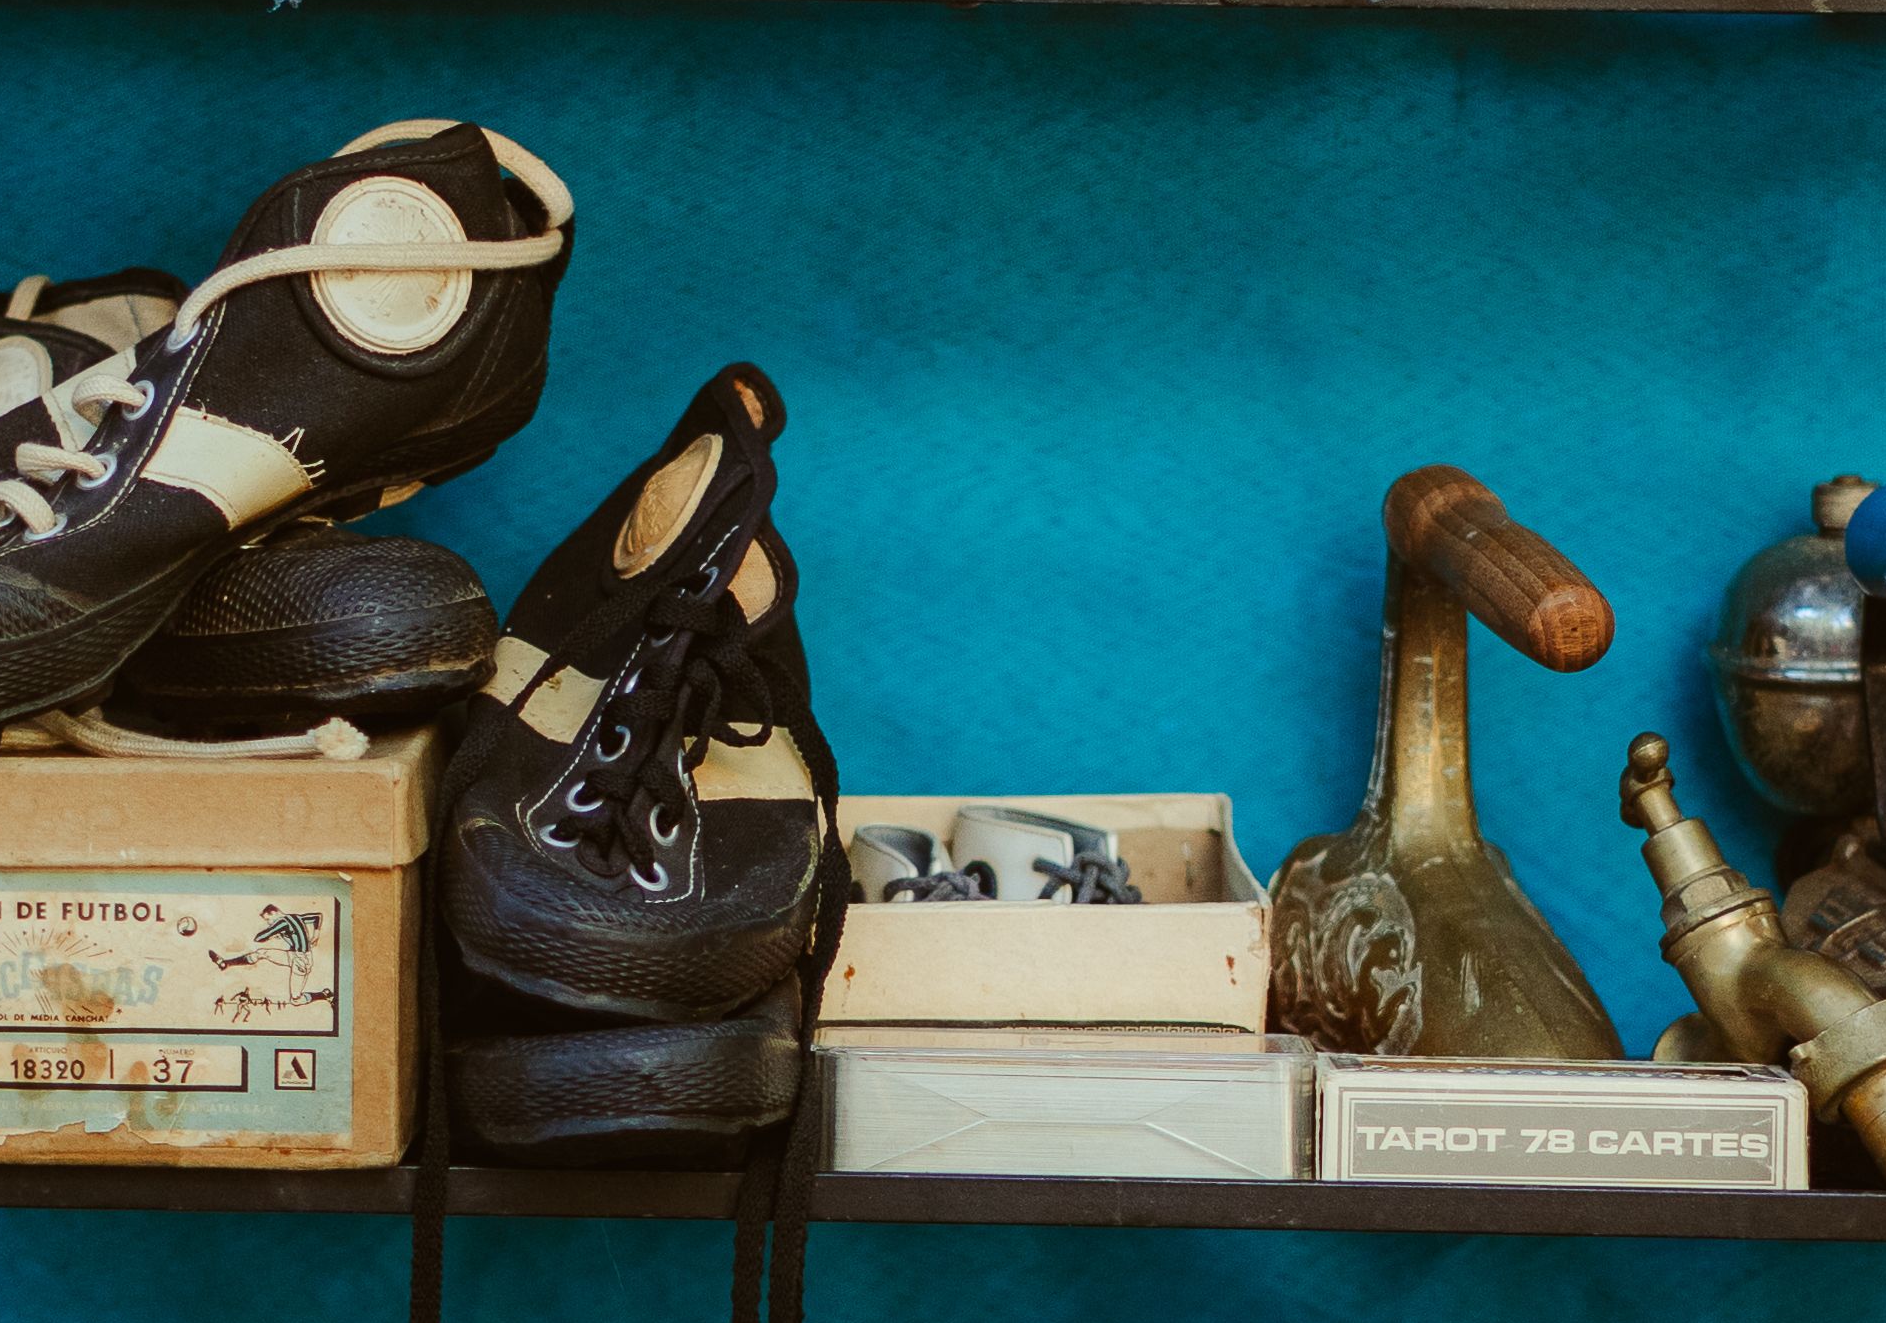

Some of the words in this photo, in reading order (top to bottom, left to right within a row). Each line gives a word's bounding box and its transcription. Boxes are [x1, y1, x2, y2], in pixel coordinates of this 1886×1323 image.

[16, 901, 48, 921] DE
[61, 902, 167, 923] FUTBOL
[14, 1014, 25, 1022] DE
[30, 1014, 59, 1022] MEDIA
[10, 1059, 85, 1080] 18320
[153, 1057, 194, 1084] 37
[1356, 1125, 1506, 1154] TAROT
[1519, 1128, 1576, 1155] 78
[1588, 1130, 1770, 1159] CARTES
